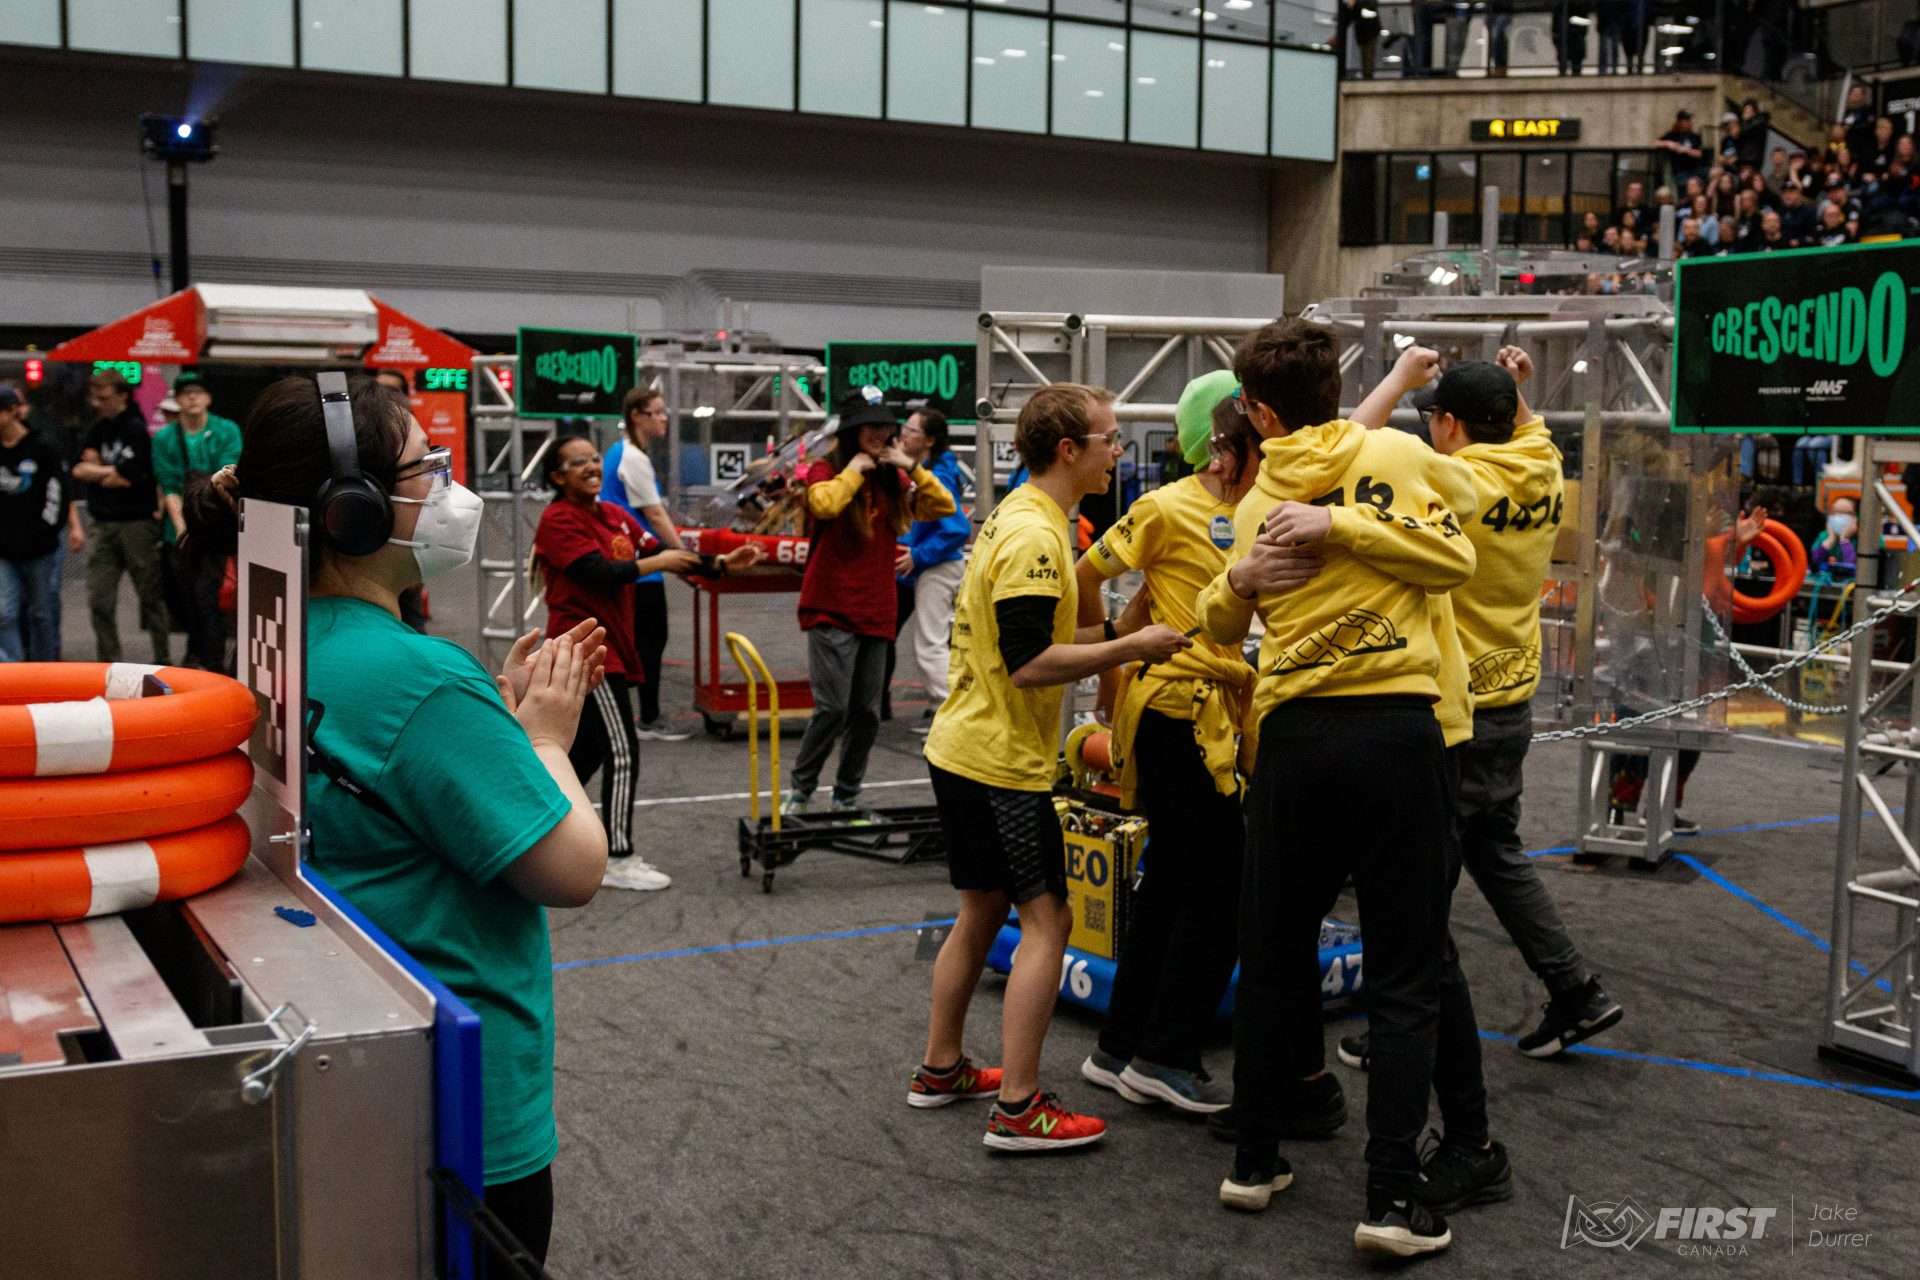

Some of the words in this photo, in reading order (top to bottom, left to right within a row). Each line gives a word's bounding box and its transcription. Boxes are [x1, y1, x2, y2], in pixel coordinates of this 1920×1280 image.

[1513, 120, 1560, 136] EAST
[1712, 271, 1906, 377] CRESCENDO
[425, 367, 469, 390] SAFE
[536, 344, 617, 393] CRESCENDO
[849, 354, 959, 399] CRESCENDO
[1026, 568, 1059, 580] 4476
[1065, 842, 1108, 887] EO
[1321, 953, 1363, 995] 47
